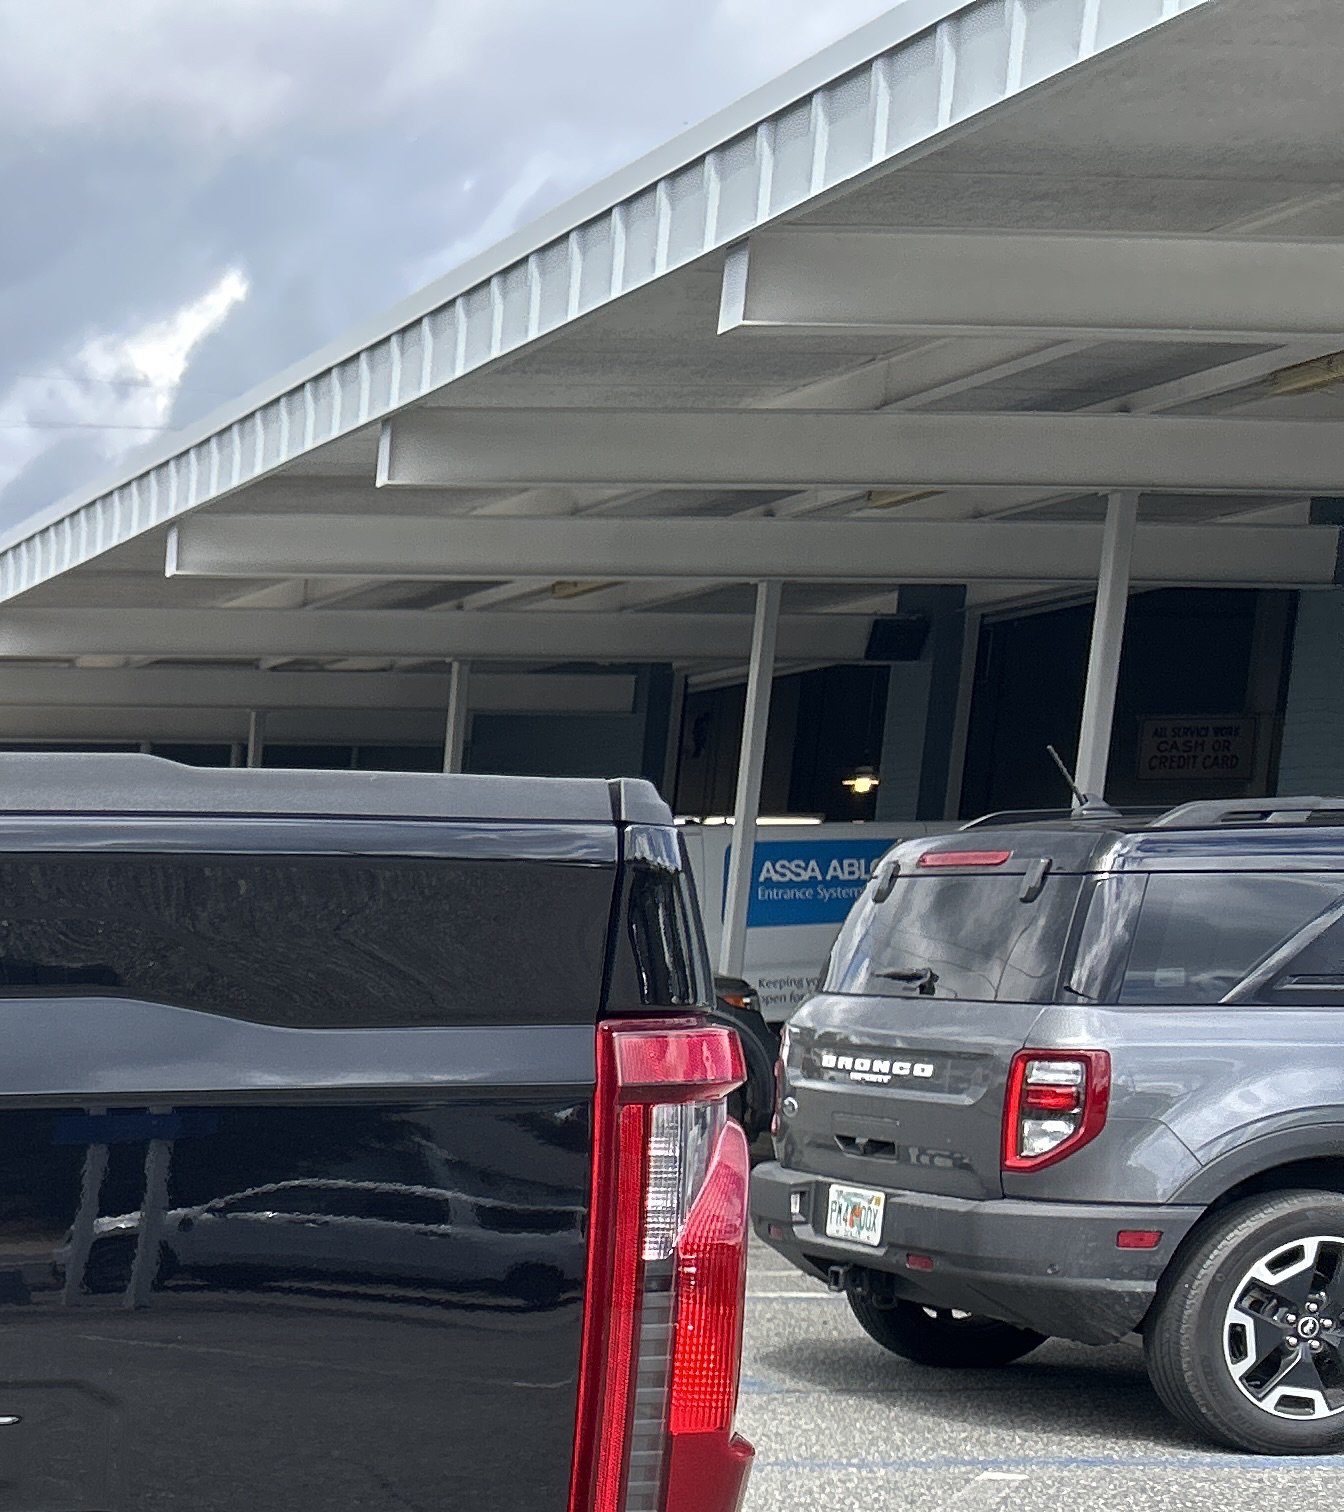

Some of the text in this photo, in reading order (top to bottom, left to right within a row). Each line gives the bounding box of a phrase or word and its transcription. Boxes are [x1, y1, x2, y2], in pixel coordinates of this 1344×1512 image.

[1156, 739, 1232, 753] CASH OR
[1148, 754, 1239, 771] CREDIT CARD
[758, 859, 823, 882] ASSA
[757, 885, 814, 901] Entrance
[822, 1054, 934, 1078] BRONCO
